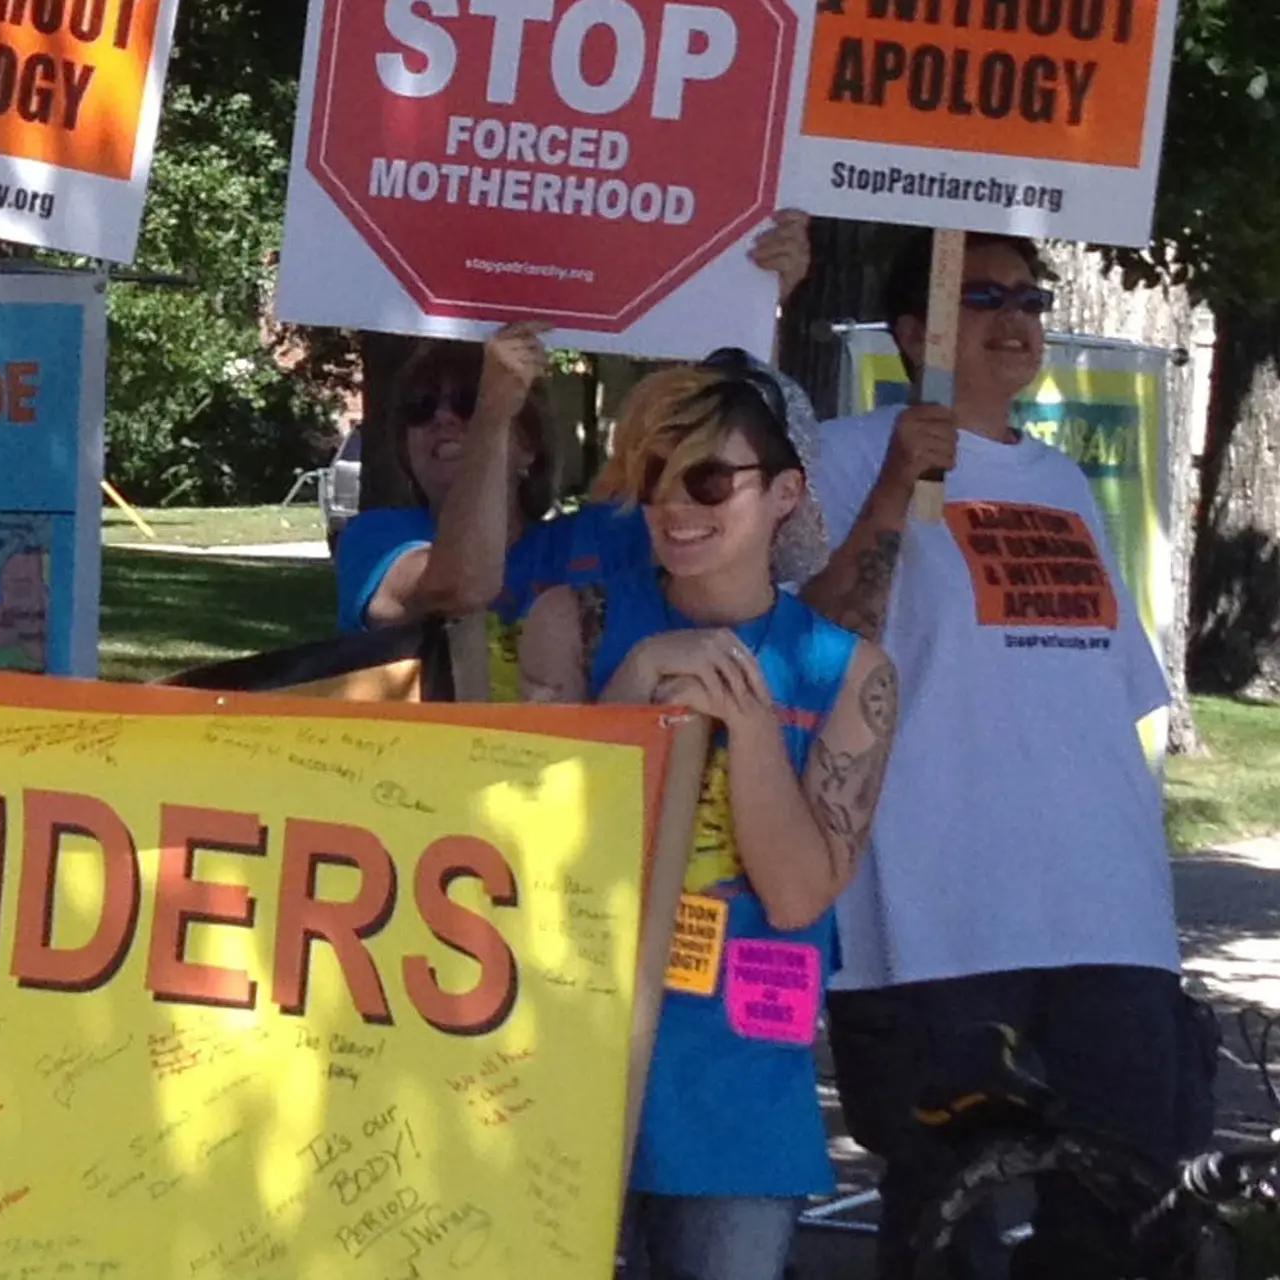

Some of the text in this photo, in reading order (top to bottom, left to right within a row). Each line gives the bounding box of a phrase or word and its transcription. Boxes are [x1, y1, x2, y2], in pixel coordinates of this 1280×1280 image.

[828, 37, 1098, 127] APOLOGY
[446, 116, 629, 167] FORCED
[368, 157, 695, 227] MOTHERHOOD
[831, 159, 1064, 214] StopPatriarchy.org
